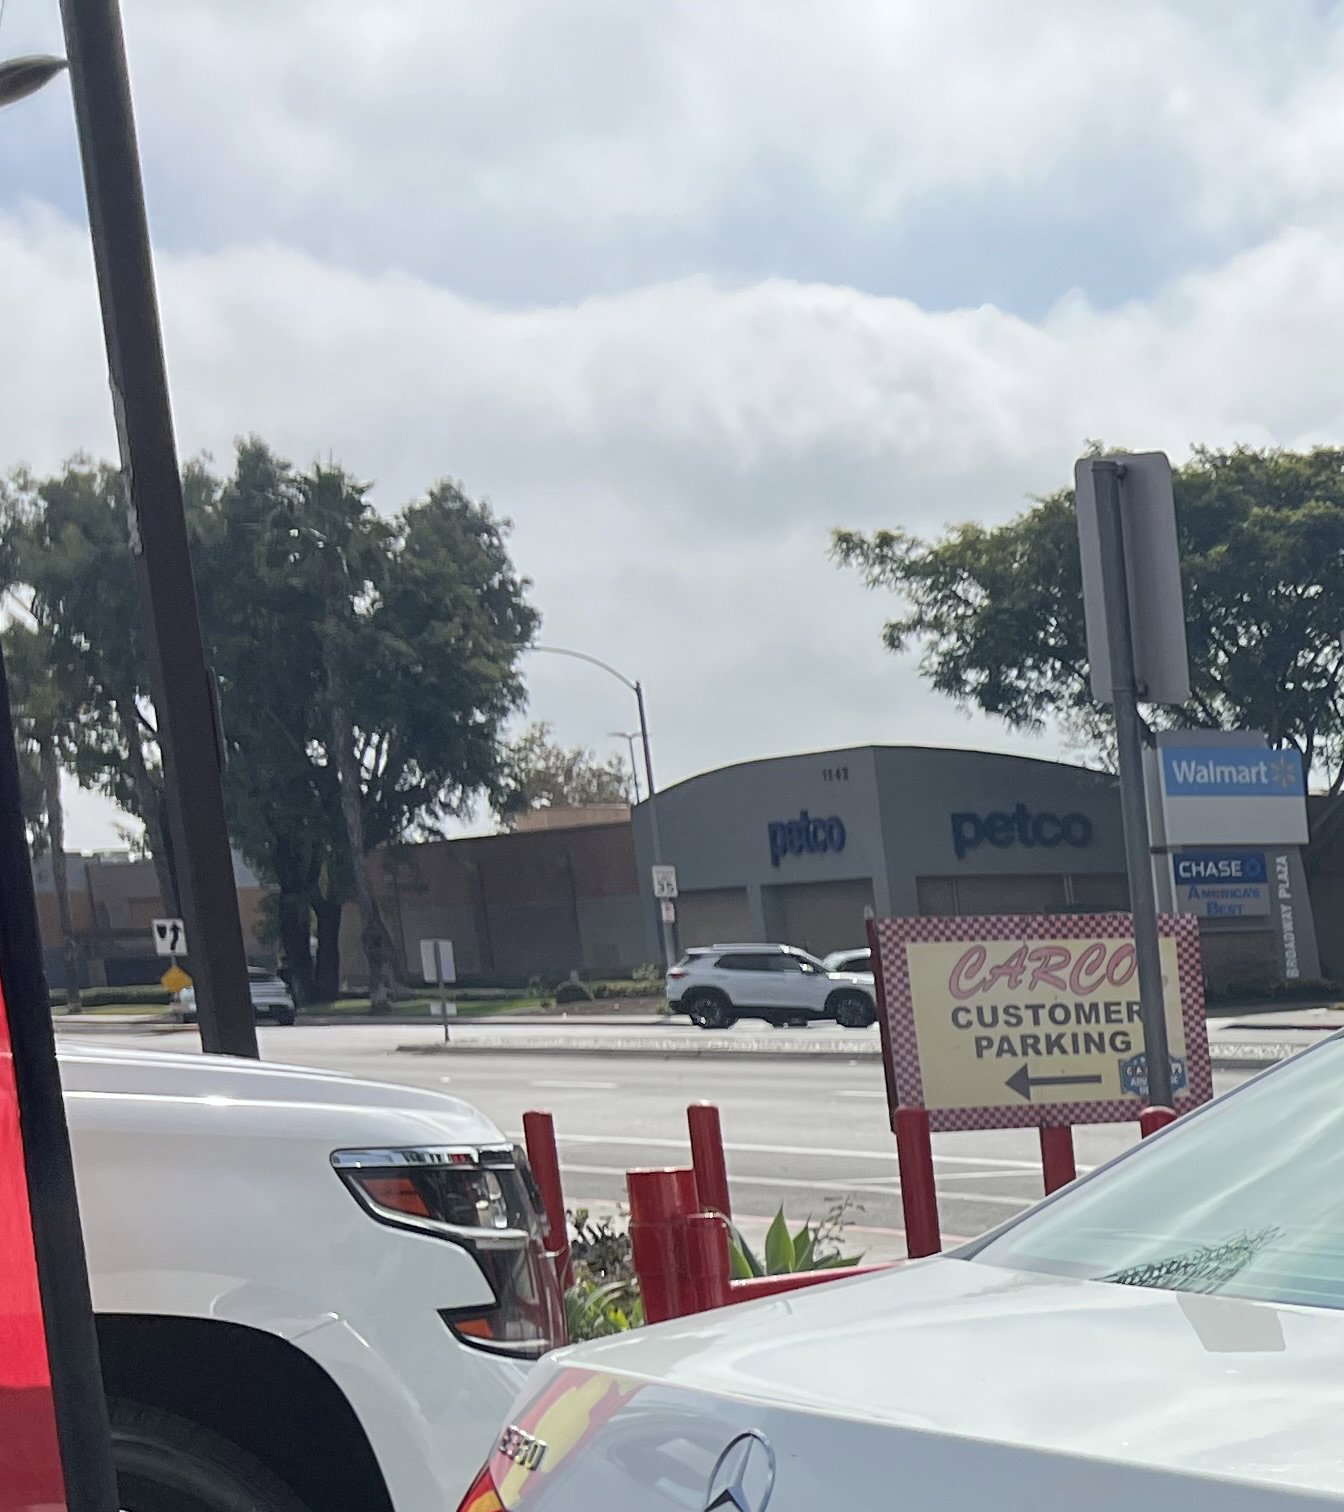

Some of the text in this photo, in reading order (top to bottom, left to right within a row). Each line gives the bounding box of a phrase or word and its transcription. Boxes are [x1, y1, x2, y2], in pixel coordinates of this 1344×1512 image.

[1172, 760, 1268, 785] Walmart
[768, 809, 846, 868] petco
[951, 803, 1093, 860] petco
[1178, 860, 1243, 878] CHASE
[1276, 855, 1299, 979] BROADWAY PLAZA
[949, 942, 1138, 1000] CARCO
[951, 1001, 1144, 1029] CUSTOMER
[974, 1030, 1132, 1058] PARKING
